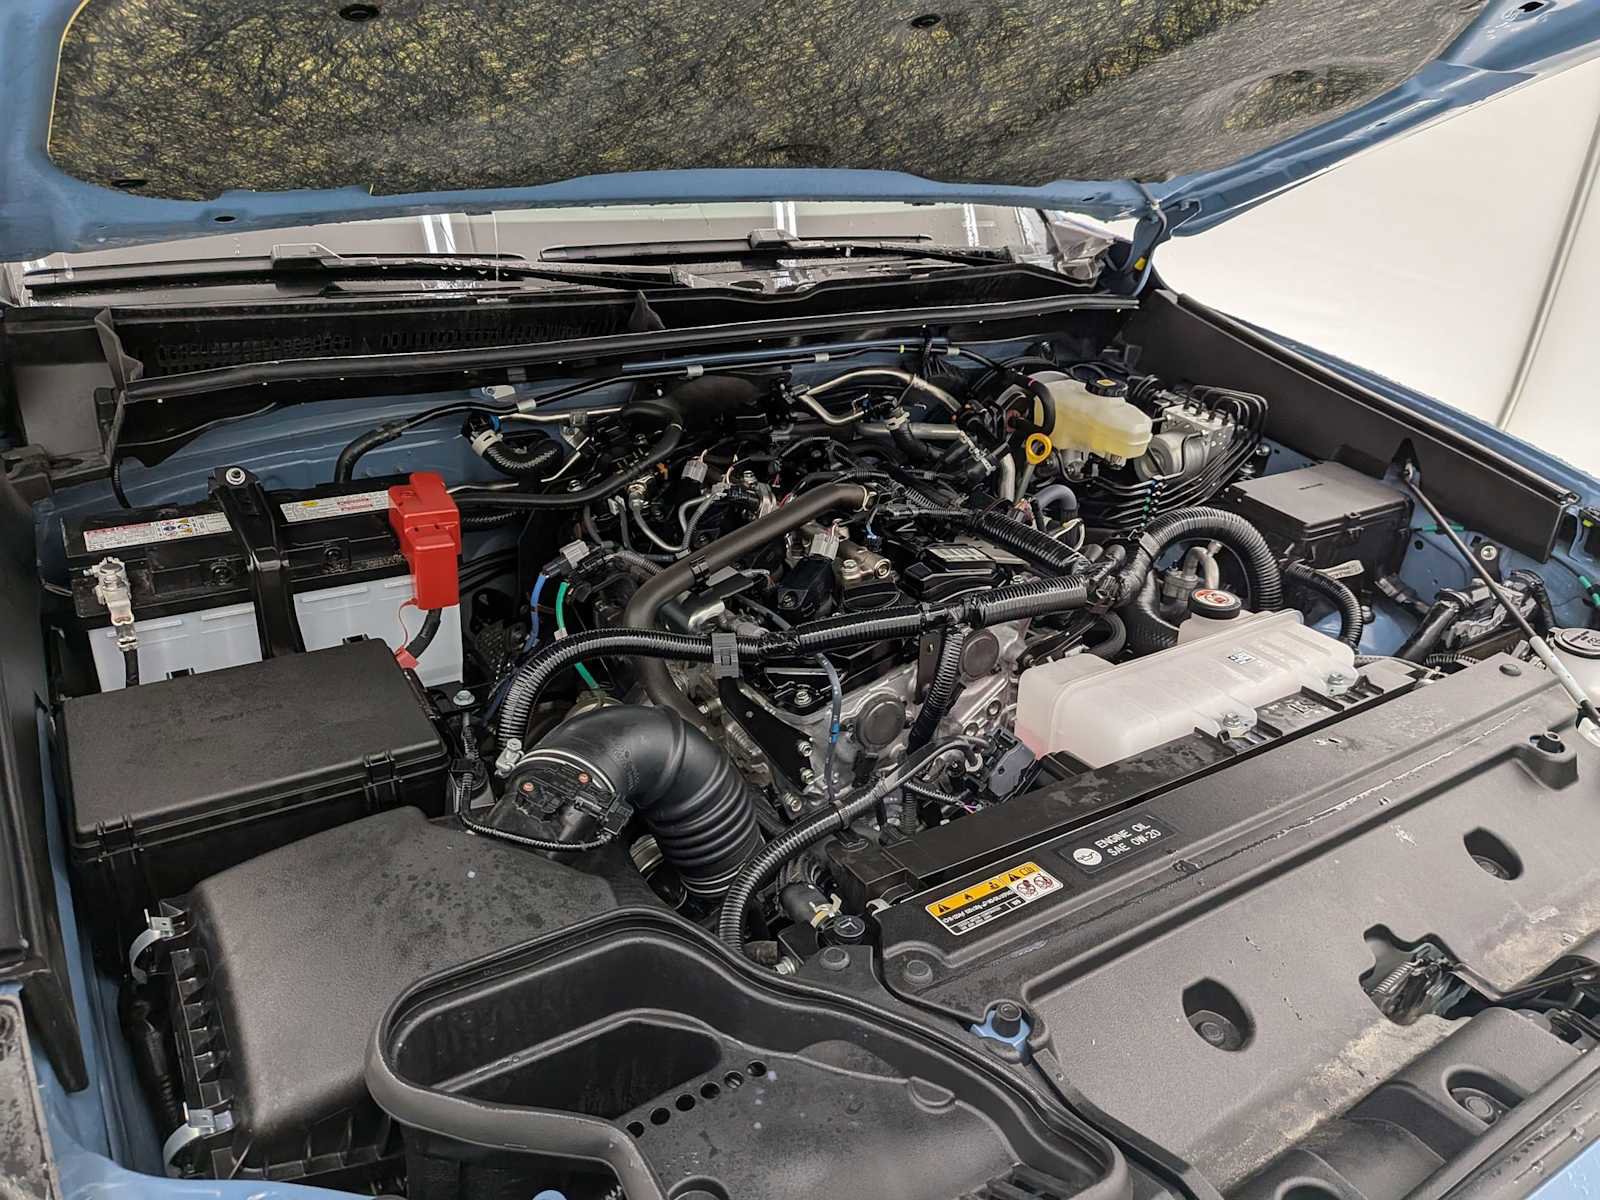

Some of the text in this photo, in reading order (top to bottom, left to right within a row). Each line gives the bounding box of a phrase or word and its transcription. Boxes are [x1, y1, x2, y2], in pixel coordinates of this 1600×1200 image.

[1094, 822, 1151, 849] ENGINE OIL
[1106, 829, 1162, 856] SAE 0W-20
